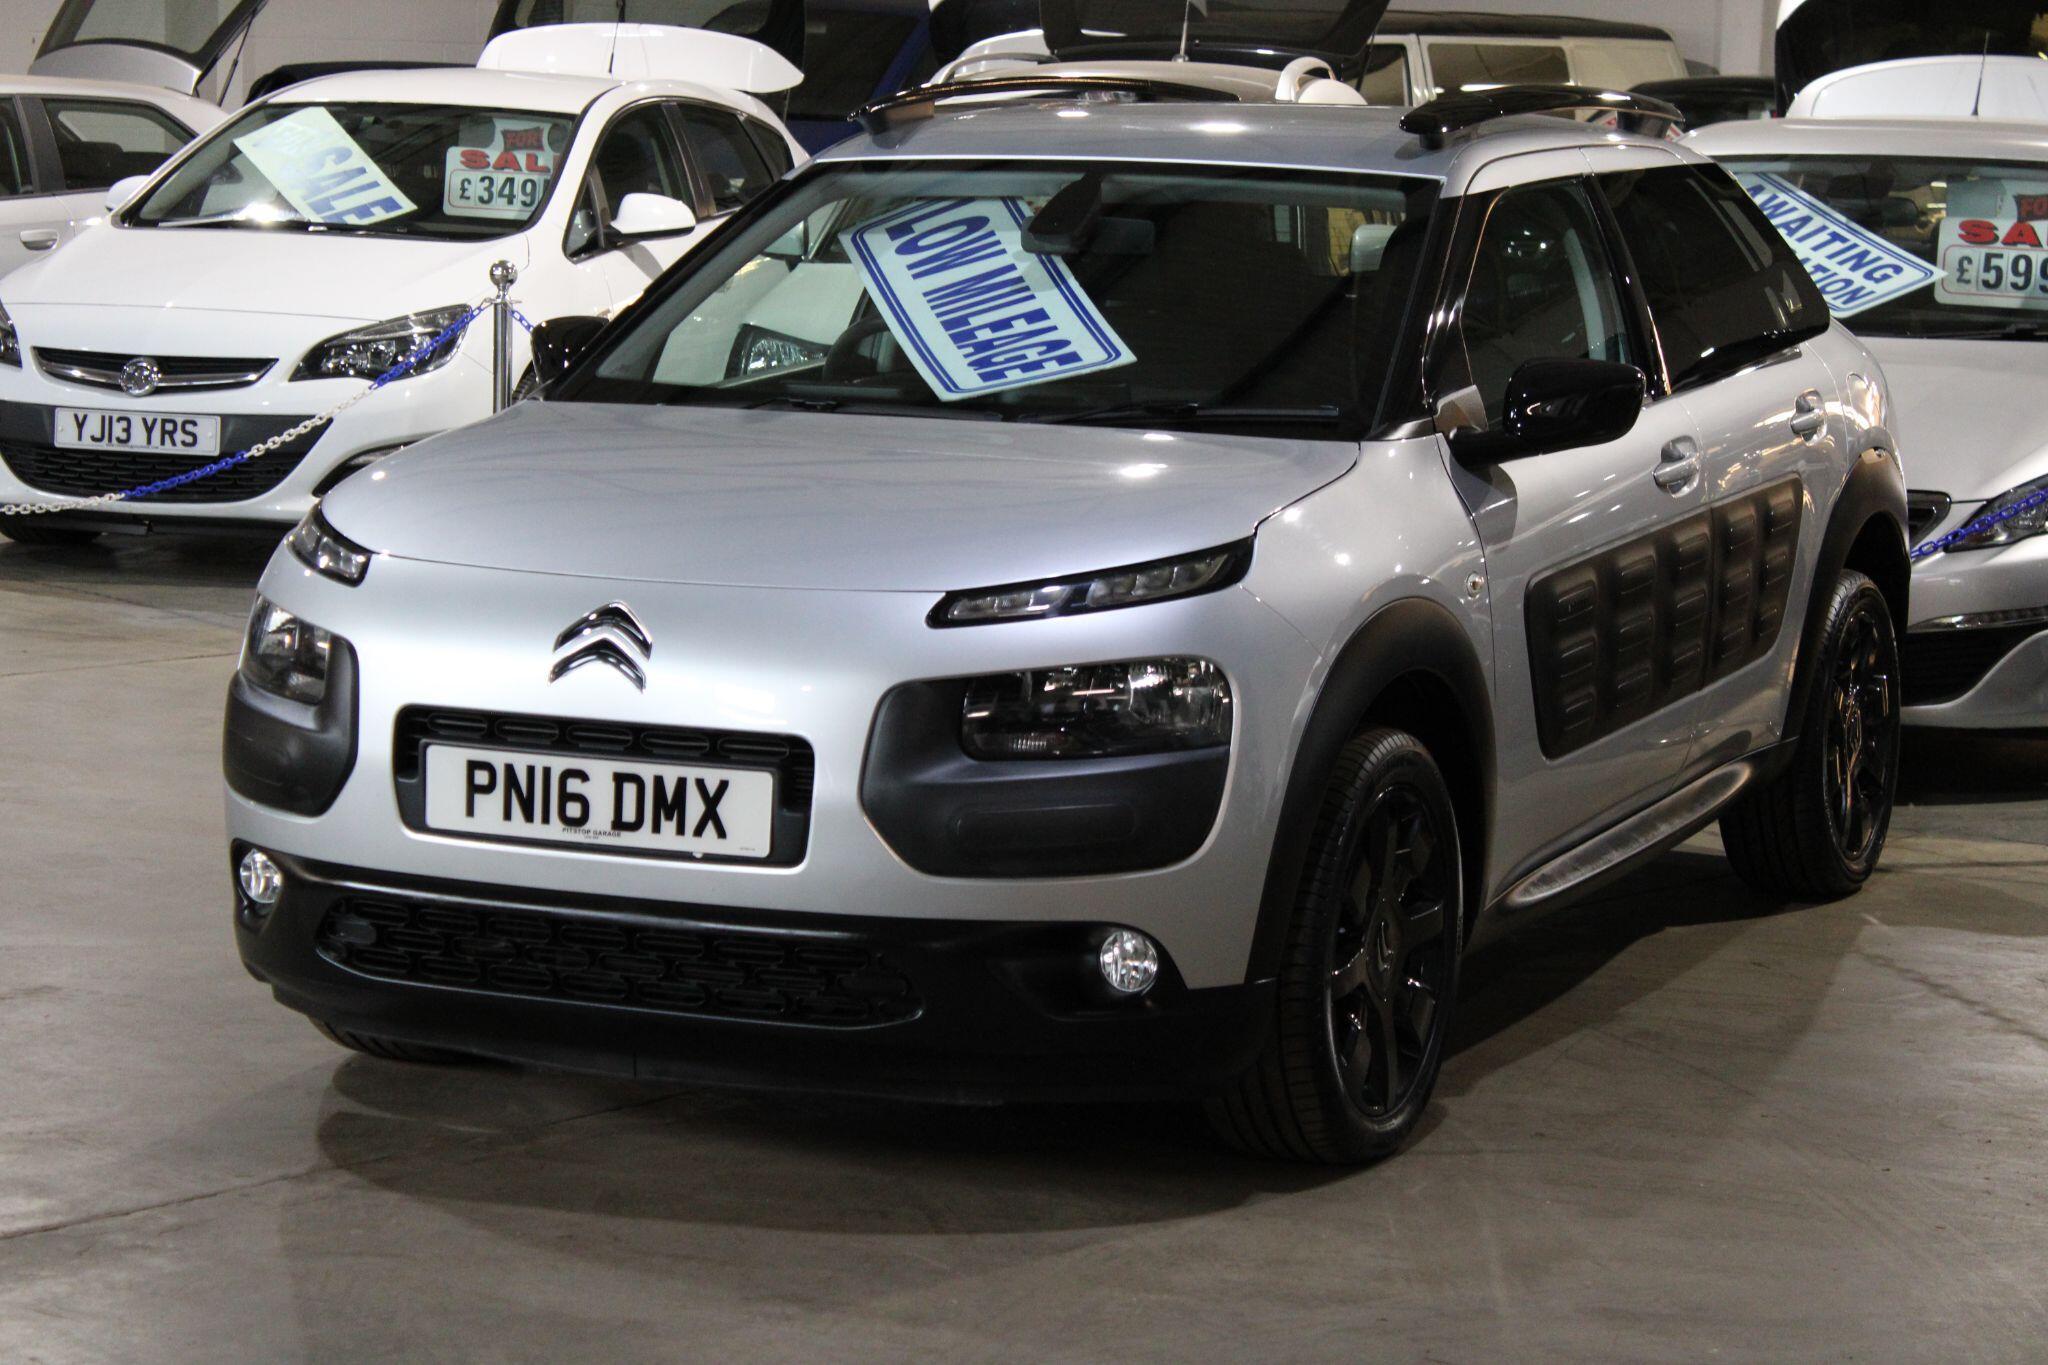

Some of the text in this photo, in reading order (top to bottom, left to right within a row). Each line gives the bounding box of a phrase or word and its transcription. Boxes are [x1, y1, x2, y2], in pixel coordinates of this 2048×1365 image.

[506, 130, 539, 148] FOR
[460, 149, 559, 173] SAL
[281, 146, 404, 224] SALE
[459, 175, 550, 208] £349
[1958, 219, 2048, 248] SA
[885, 200, 1083, 384] LOW MILEAGE
[1800, 257, 1876, 306] TION
[73, 413, 198, 448] YJ13 YRS
[465, 759, 729, 840] PN16 DMX
[562, 827, 591, 835] PITSTOP
[593, 830, 622, 838] GARAGE
